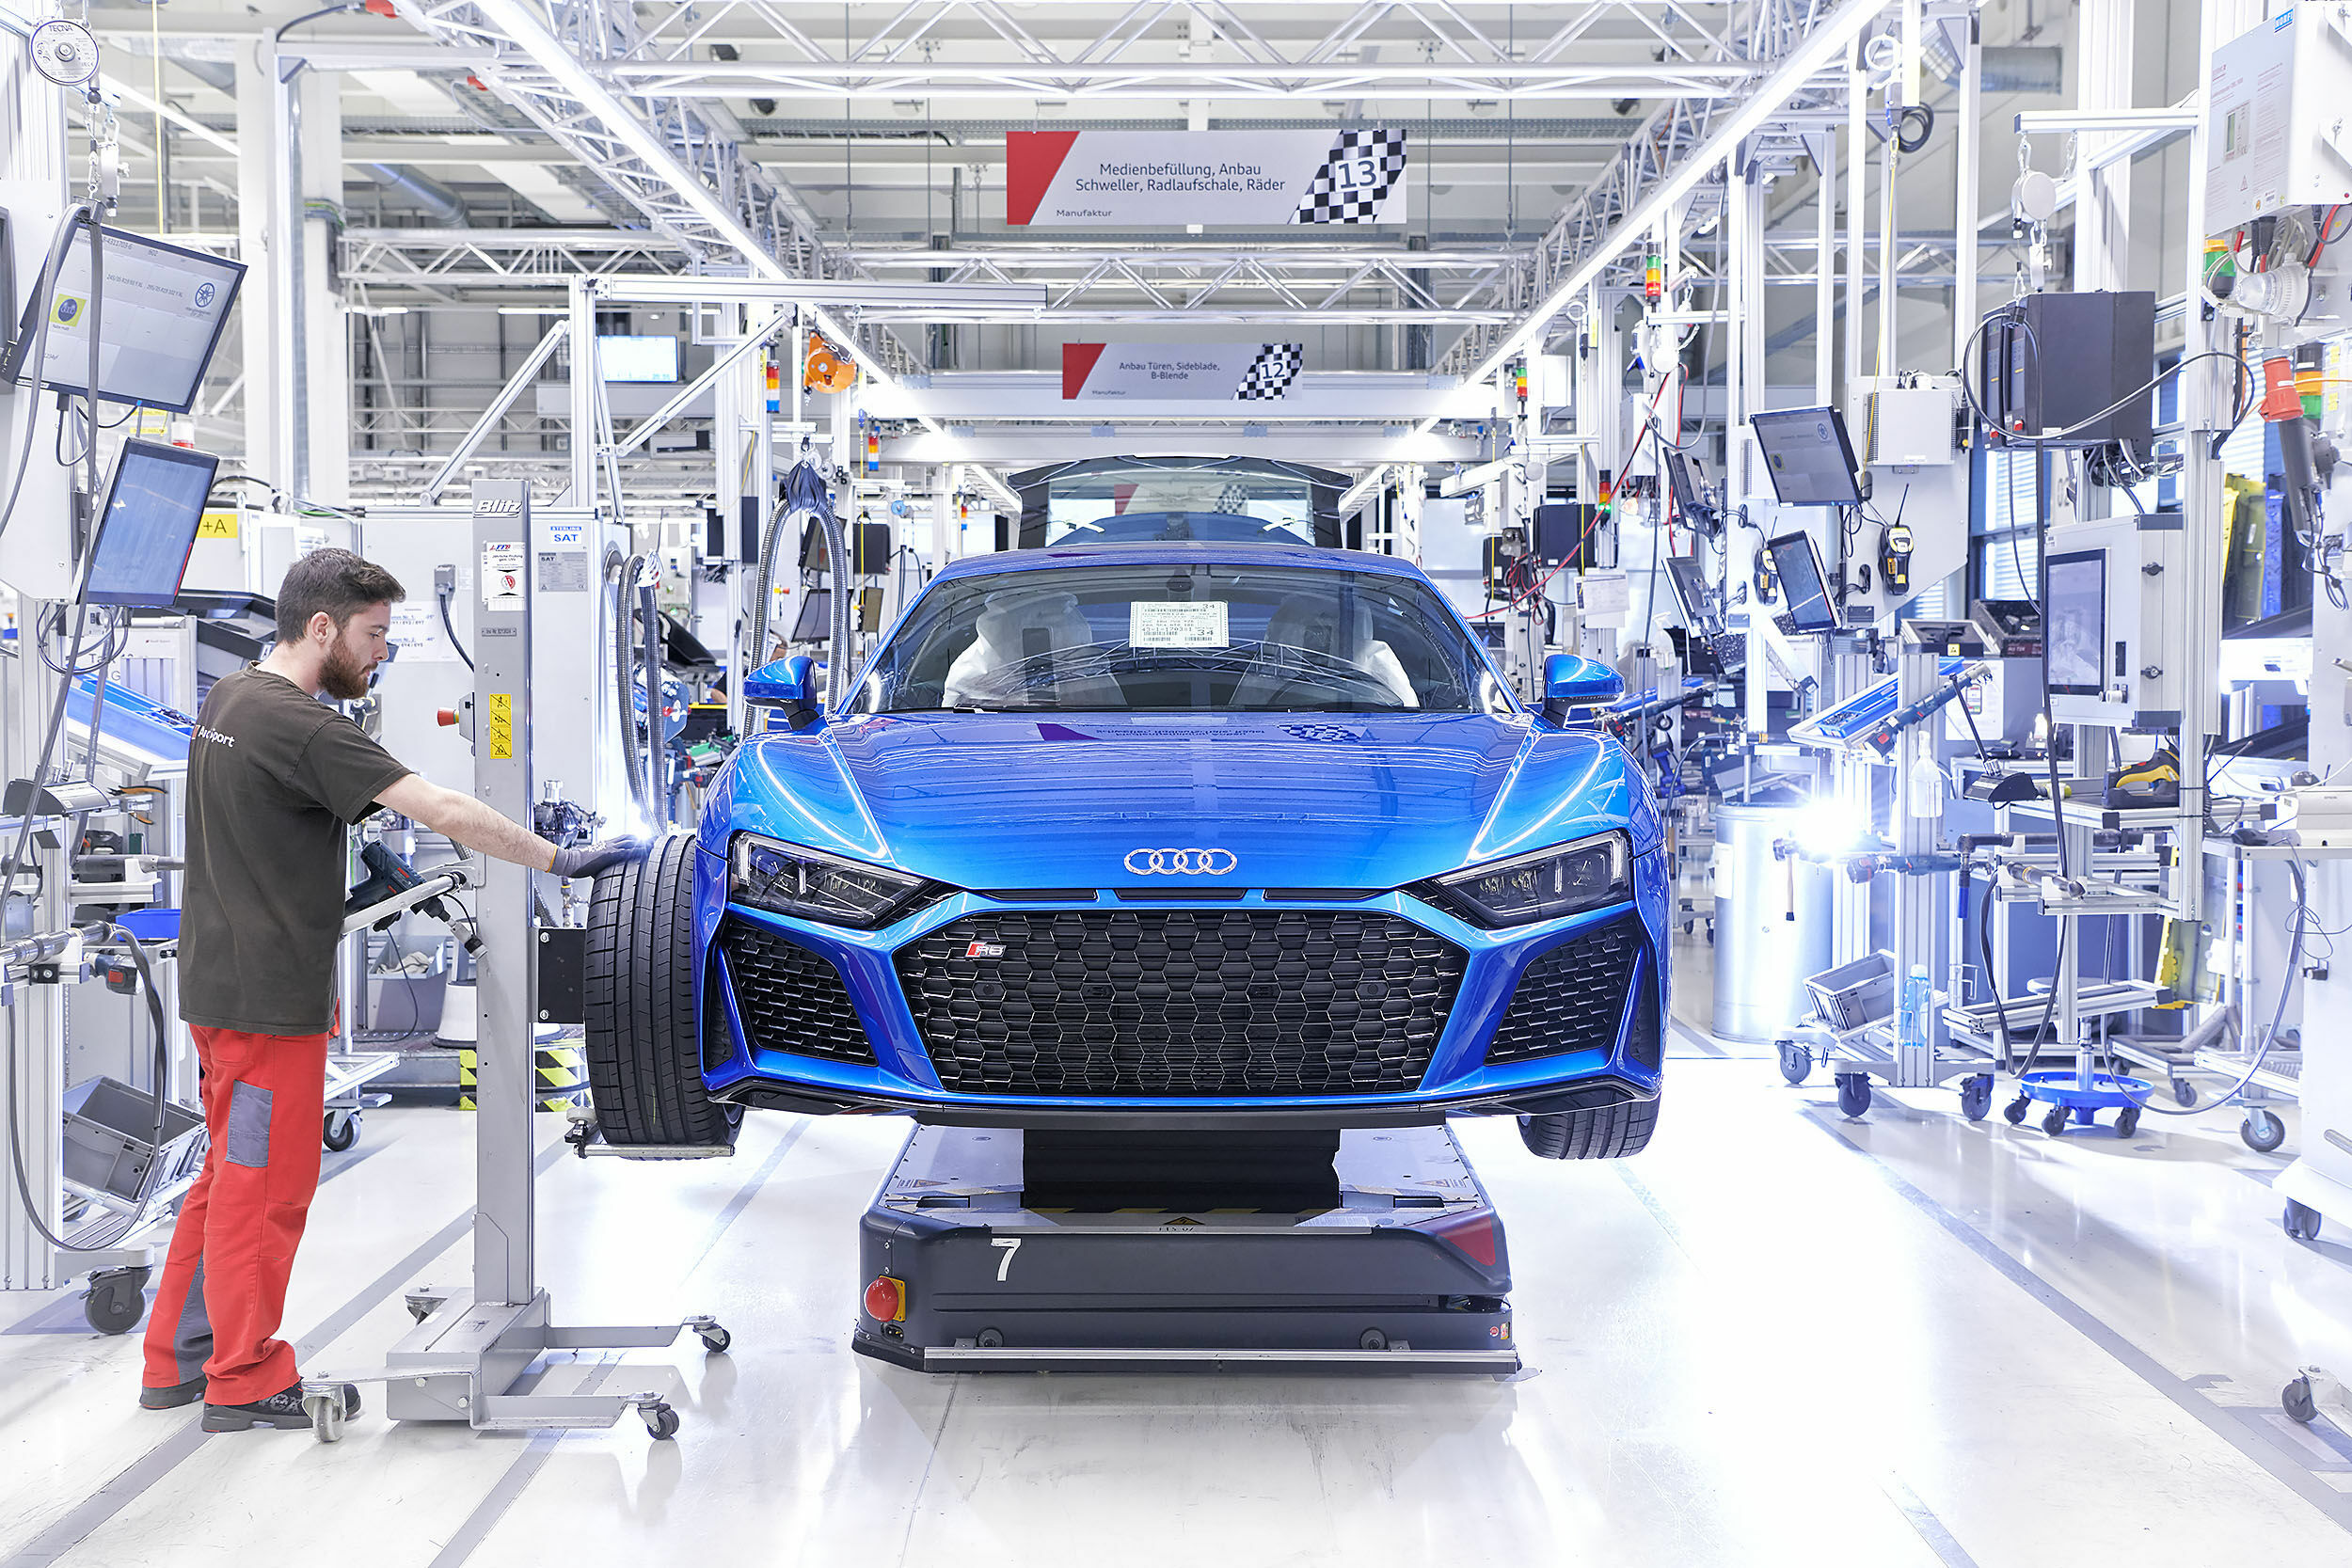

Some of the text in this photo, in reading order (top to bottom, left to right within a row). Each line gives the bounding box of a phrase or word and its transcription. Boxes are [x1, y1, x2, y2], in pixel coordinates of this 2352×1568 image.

[1100, 164, 1262, 177] Medienbefüllung, Anbau
[1338, 160, 1377, 189] 13
[1075, 179, 1286, 193] Schweller, Radlaufschale, Räder
[1056, 209, 1113, 217] Manufaktur
[1119, 361, 1220, 372] Anbau Türen, Sideblade,
[1261, 362, 1286, 380] 12
[1151, 372, 1189, 380] B-Blende
[474, 499, 523, 514] Blitz
[202, 518, 228, 534] +A
[553, 533, 579, 543] SAT
[975, 944, 1007, 958] R8
[991, 1237, 1023, 1282] 7
